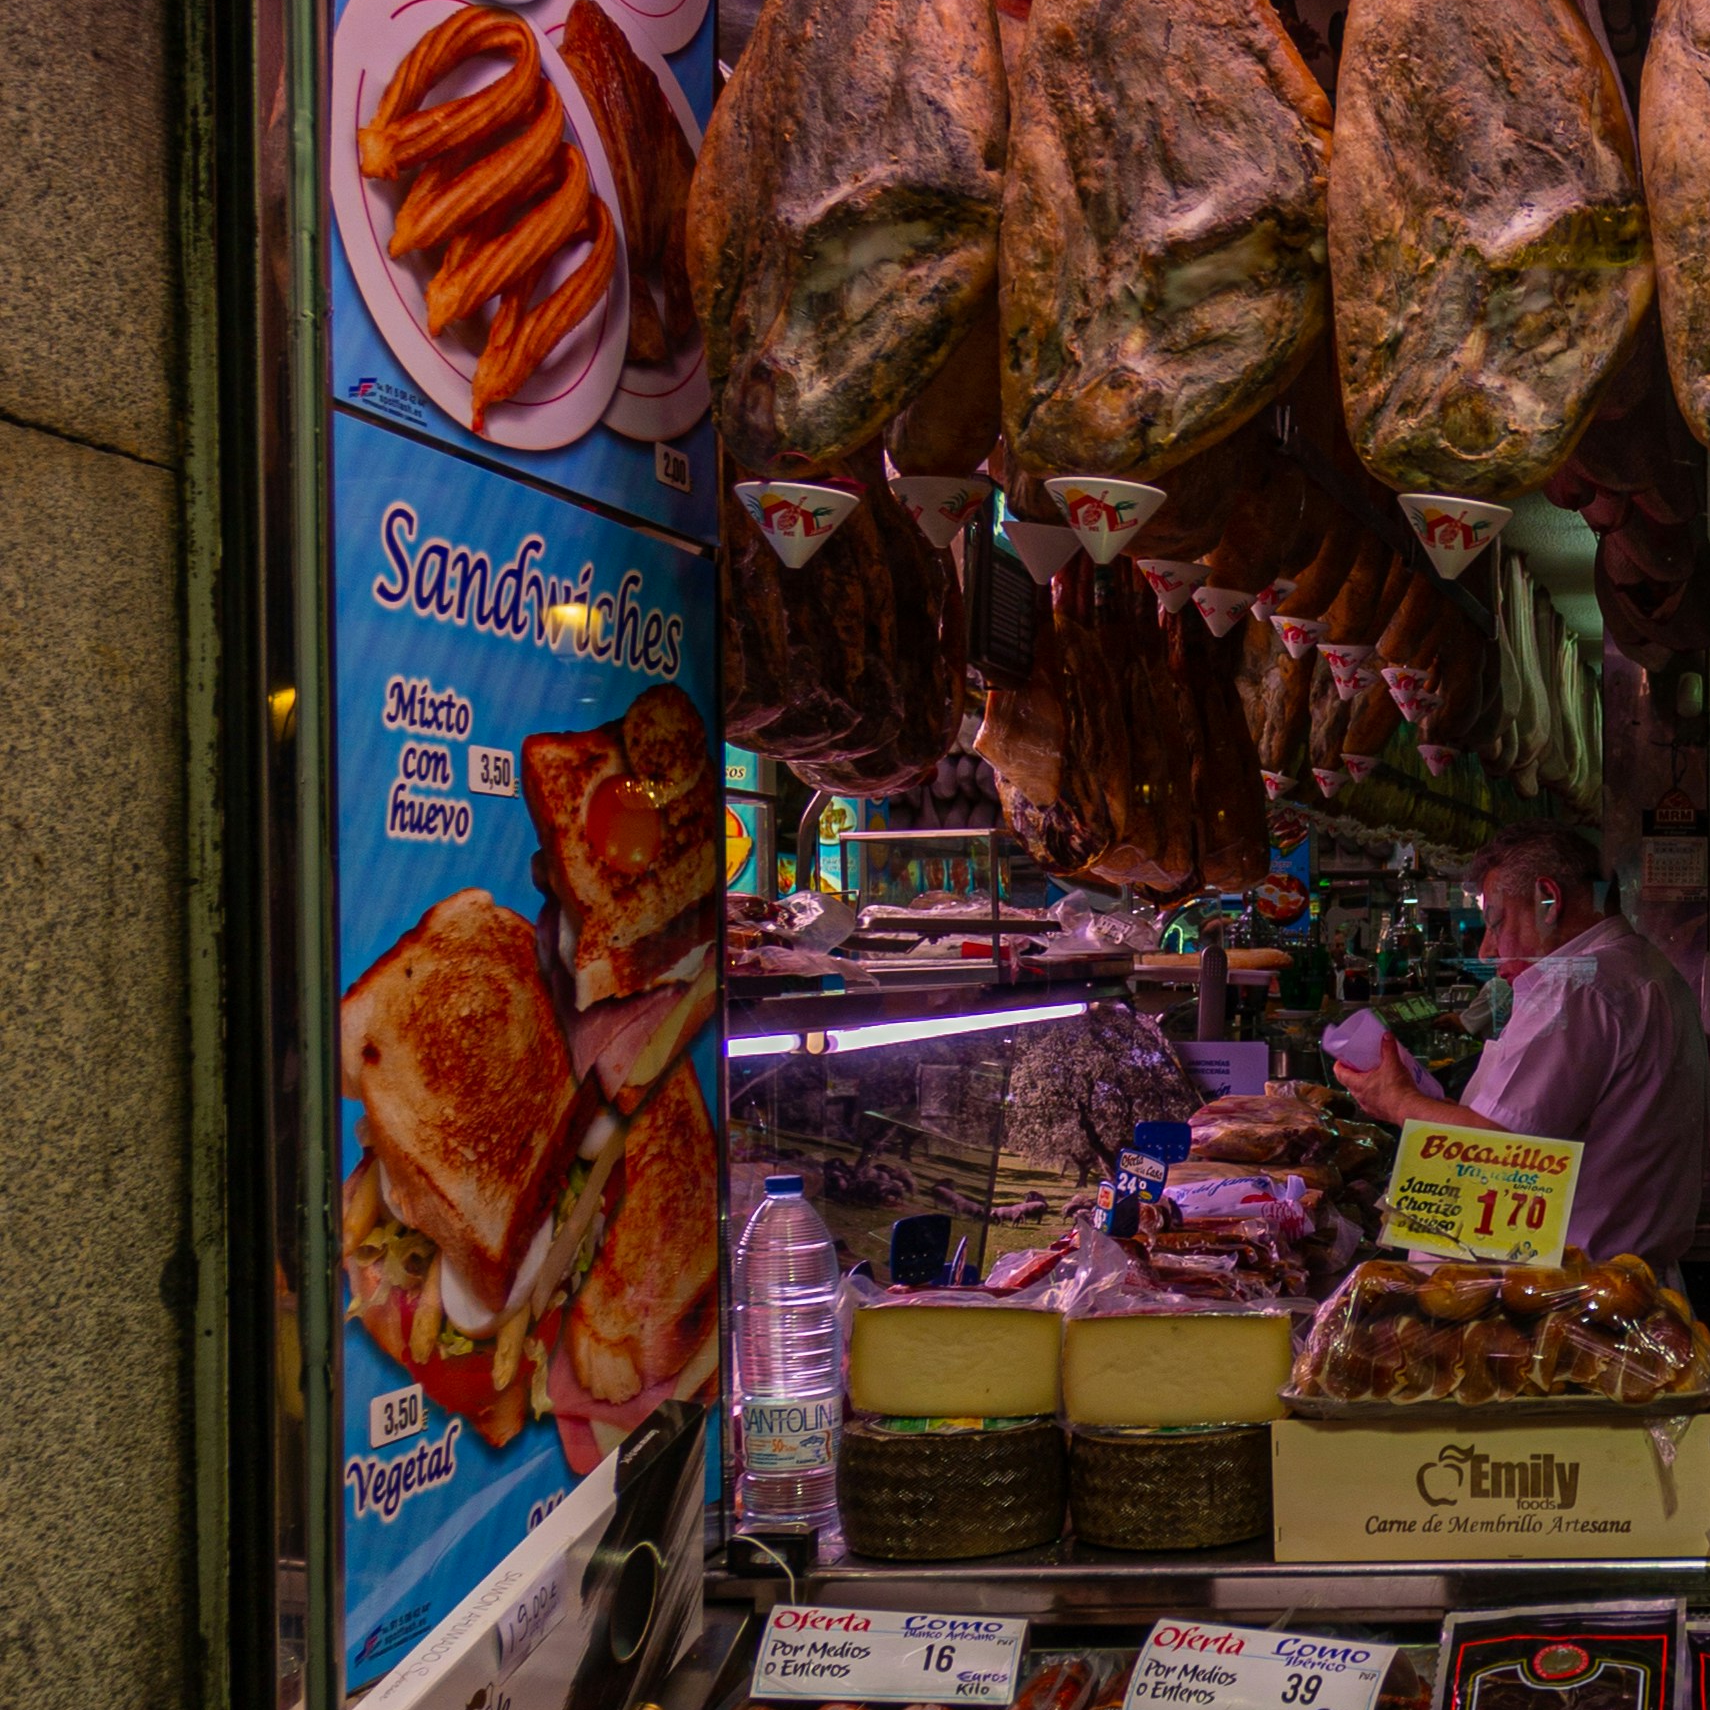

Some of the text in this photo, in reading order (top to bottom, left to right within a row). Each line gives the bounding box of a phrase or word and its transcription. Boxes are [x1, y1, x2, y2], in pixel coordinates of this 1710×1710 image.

[376, 507, 682, 675] Sandwiches
[385, 680, 470, 735] Mixto
[403, 746, 450, 784] con
[480, 753, 511, 789] 3,50
[389, 783, 470, 839] huevo
[1399, 1176, 1462, 1200] Jamón
[1513, 1183, 1554, 1195] UNIDAD
[1396, 1195, 1463, 1218] Chorizo
[384, 1393, 418, 1437] 3,50
[346, 1424, 460, 1516] Vegetal
[1470, 1452, 1581, 1511] Emily
[1516, 1497, 1557, 1511] foods
[1365, 1512, 1633, 1536] Carne de Membrillo Artesana
[773, 1609, 872, 1633] Oferta
[770, 1639, 871, 1660] Por Medios
[1152, 1625, 1246, 1657] Oferta
[781, 1659, 851, 1679] Enteros
[922, 1643, 956, 1674] 16
[1144, 1657, 1238, 1687] Por Medios
[1283, 1655, 1347, 1674] Ibérico
[955, 1682, 990, 1697] Kilo
[1150, 1682, 1217, 1706] Enteros
[1280, 1672, 1324, 1706] 39
